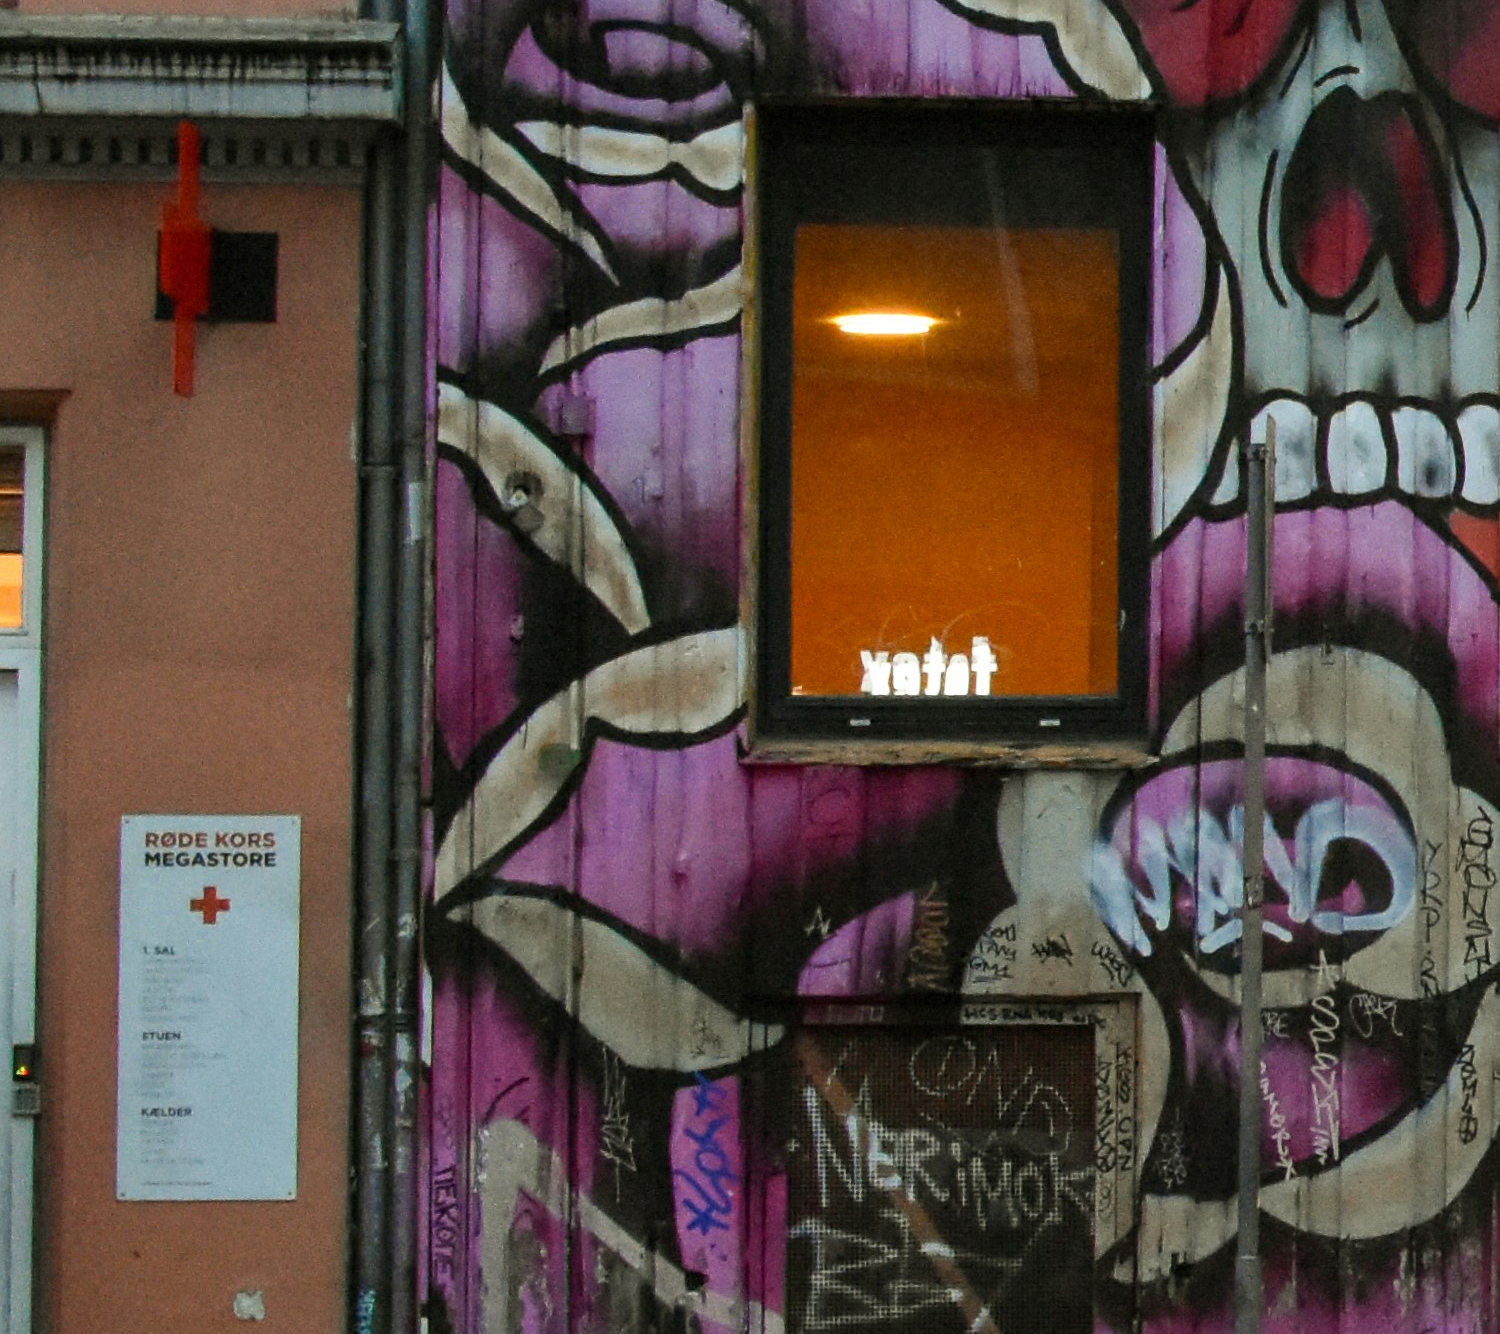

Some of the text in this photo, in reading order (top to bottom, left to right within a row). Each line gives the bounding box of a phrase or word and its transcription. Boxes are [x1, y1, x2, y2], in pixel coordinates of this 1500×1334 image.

[145, 831, 276, 848] RØDE KORS
[144, 851, 277, 868] MEGASTORE
